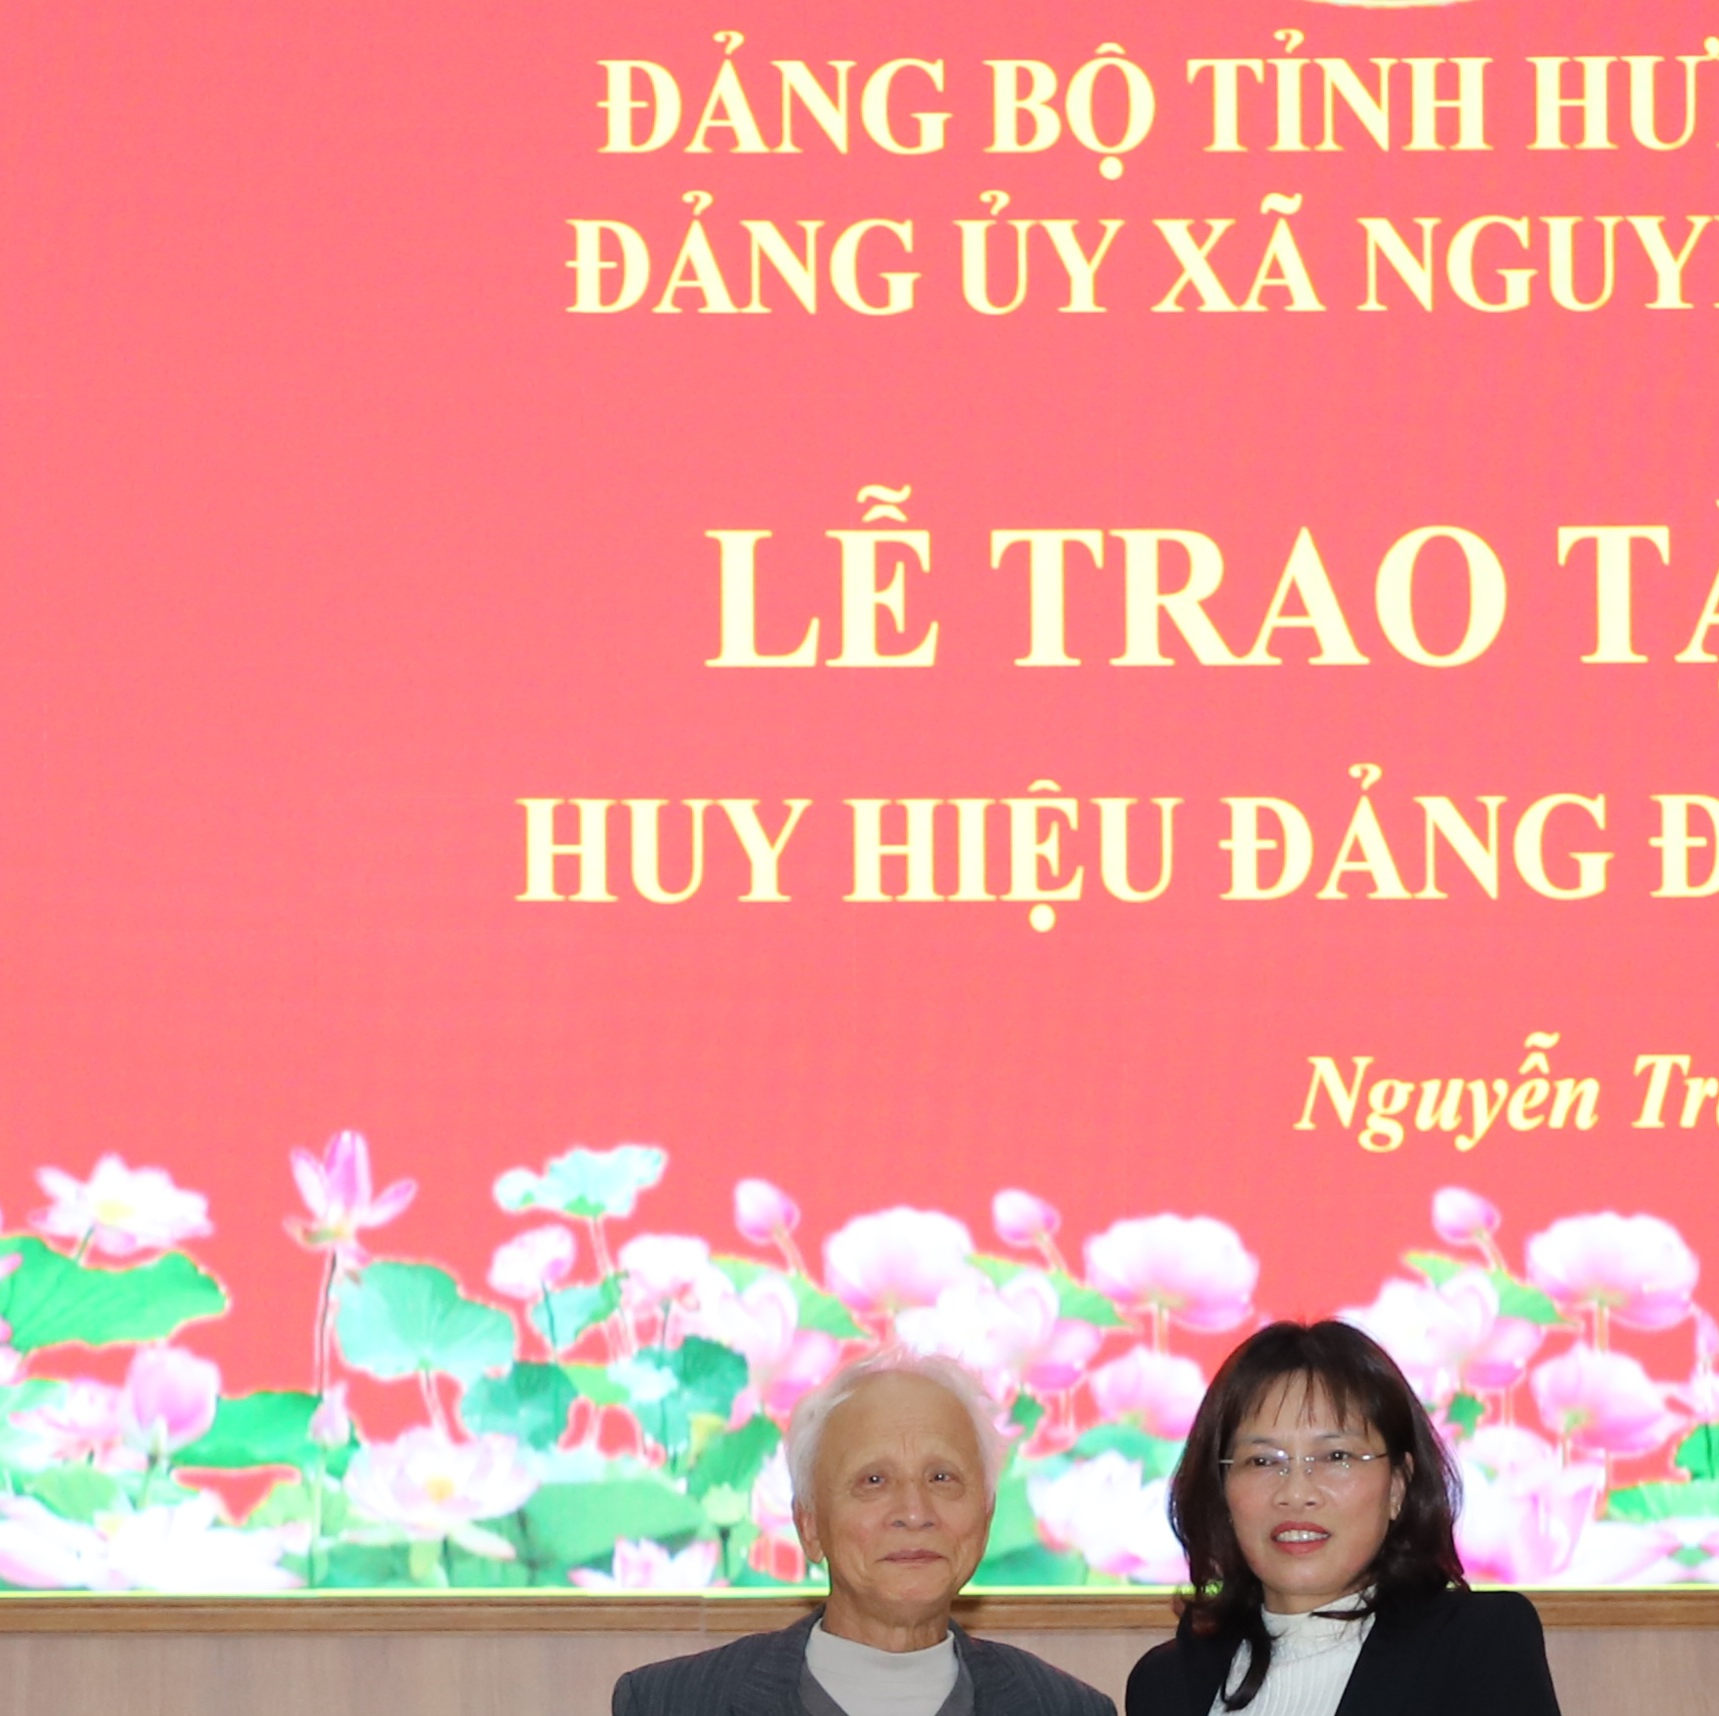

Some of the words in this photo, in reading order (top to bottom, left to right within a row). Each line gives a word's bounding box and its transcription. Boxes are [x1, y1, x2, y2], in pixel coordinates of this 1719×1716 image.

[597, 31, 952, 154] ĐẢNG
[983, 43, 1155, 180] BỘ
[1187, 29, 1493, 152] TỈNH
[566, 190, 921, 315] ĐẢNG
[954, 190, 1124, 315] ỦY
[1151, 193, 1326, 312] XÃ
[705, 485, 938, 667] LỄ
[991, 526, 1507, 667] TRAO
[515, 798, 812, 904] HUY
[843, 779, 1183, 932] HIỆU
[1219, 763, 1614, 900] ĐẢNG
[1294, 1032, 1600, 1152] Nguyễn
